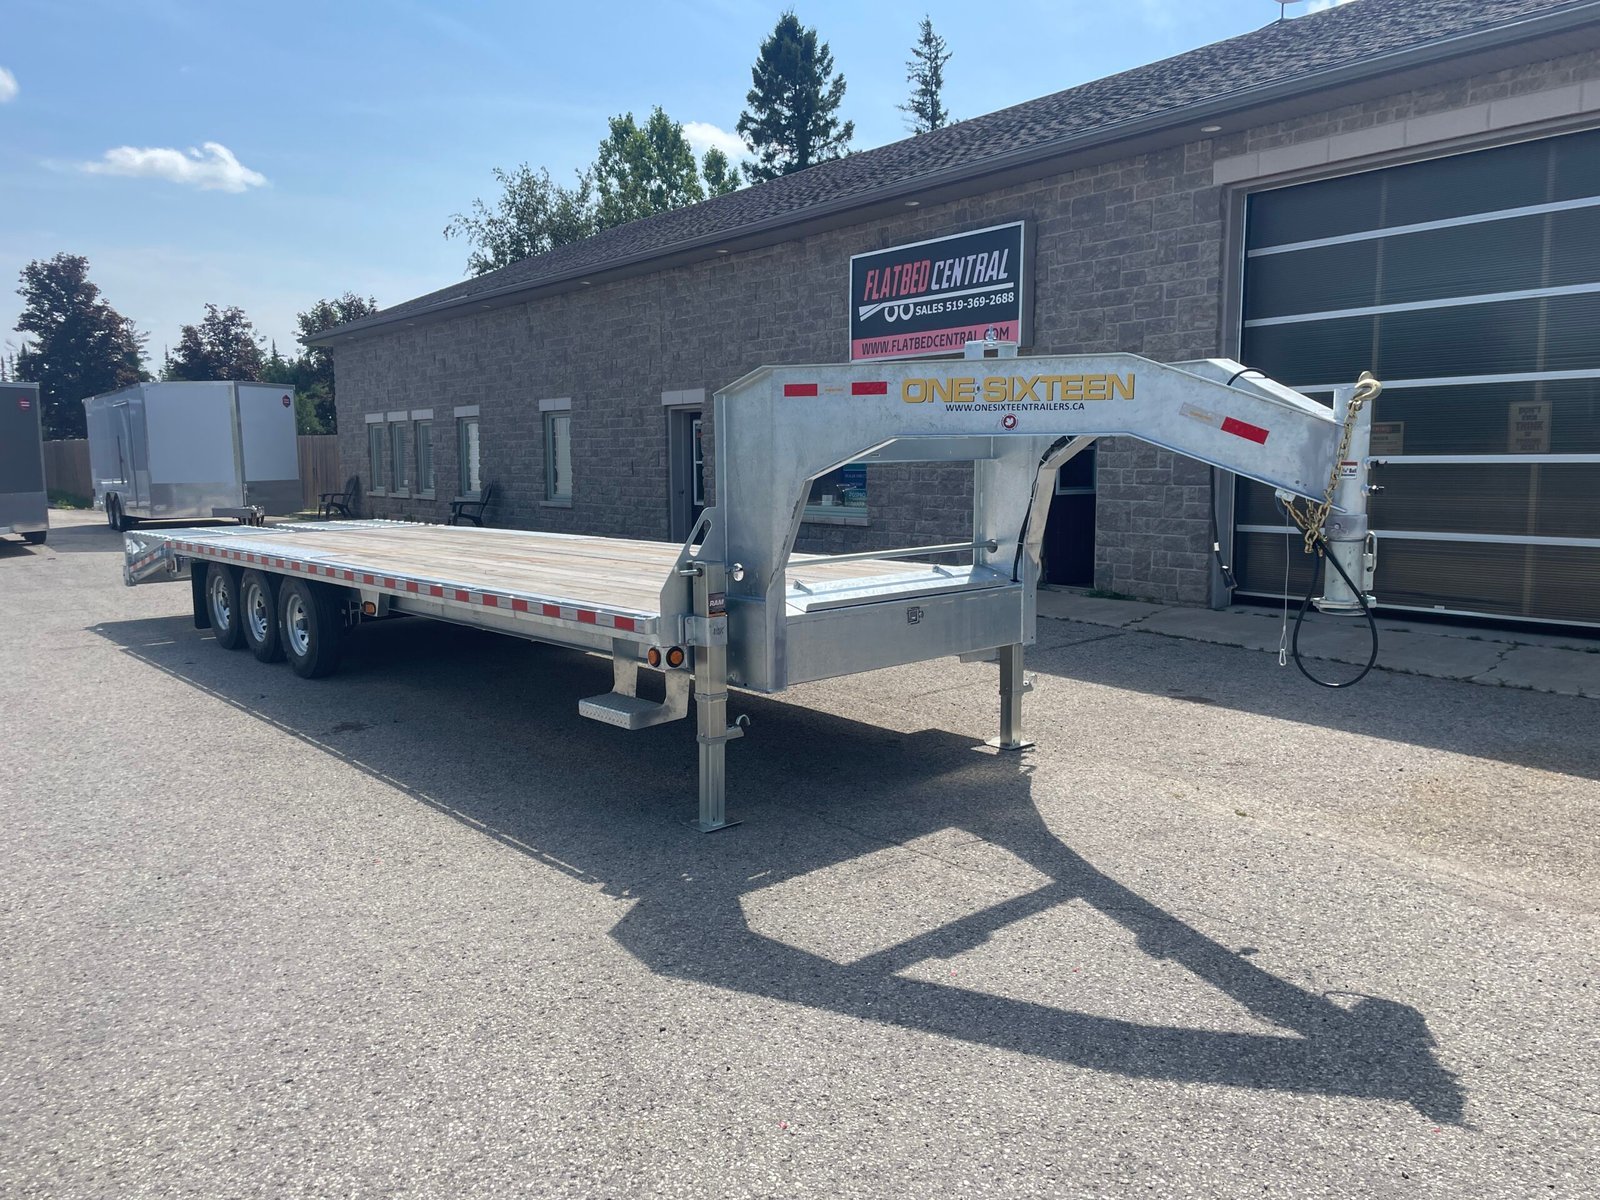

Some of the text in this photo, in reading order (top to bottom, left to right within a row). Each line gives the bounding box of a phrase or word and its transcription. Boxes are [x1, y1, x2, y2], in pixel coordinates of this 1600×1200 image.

[863, 248, 1009, 301] FLATBED CENTRAL
[915, 291, 1015, 316] SALES 519-369-2688
[902, 373, 1136, 403] ONE SIXTEEN
[945, 402, 1085, 412] WWW.ONESIXTEENTRAILERS.CA
[709, 599, 725, 607] RAM
